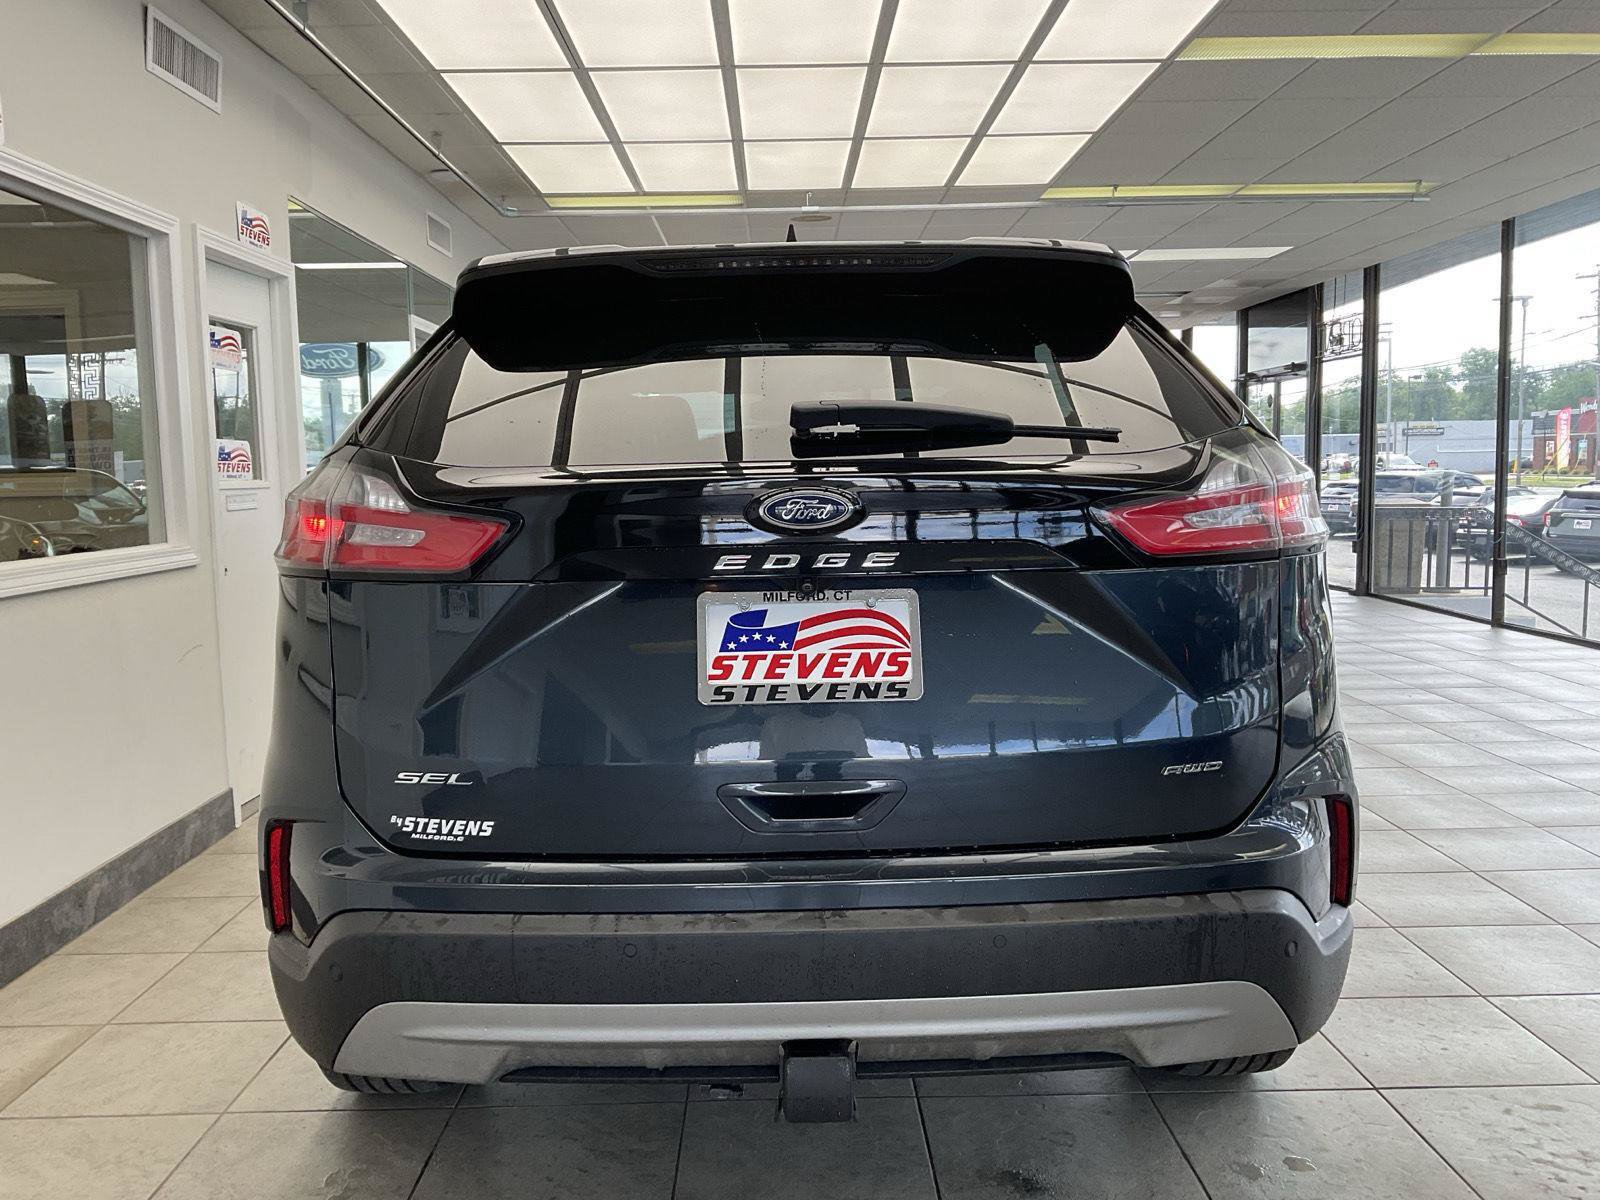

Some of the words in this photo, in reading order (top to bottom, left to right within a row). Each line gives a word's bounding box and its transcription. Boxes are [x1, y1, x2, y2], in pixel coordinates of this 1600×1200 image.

[240, 225, 270, 246] STEVENS
[217, 462, 251, 473] STEVENS
[781, 498, 832, 520] Ford
[713, 551, 900, 570] EDGE
[833, 590, 852, 601] CT
[707, 652, 912, 681] STEVENS
[710, 682, 911, 702] STEVENS
[1161, 760, 1223, 776] AWD
[394, 772, 474, 785] SEL
[402, 817, 495, 837] STEVENS
